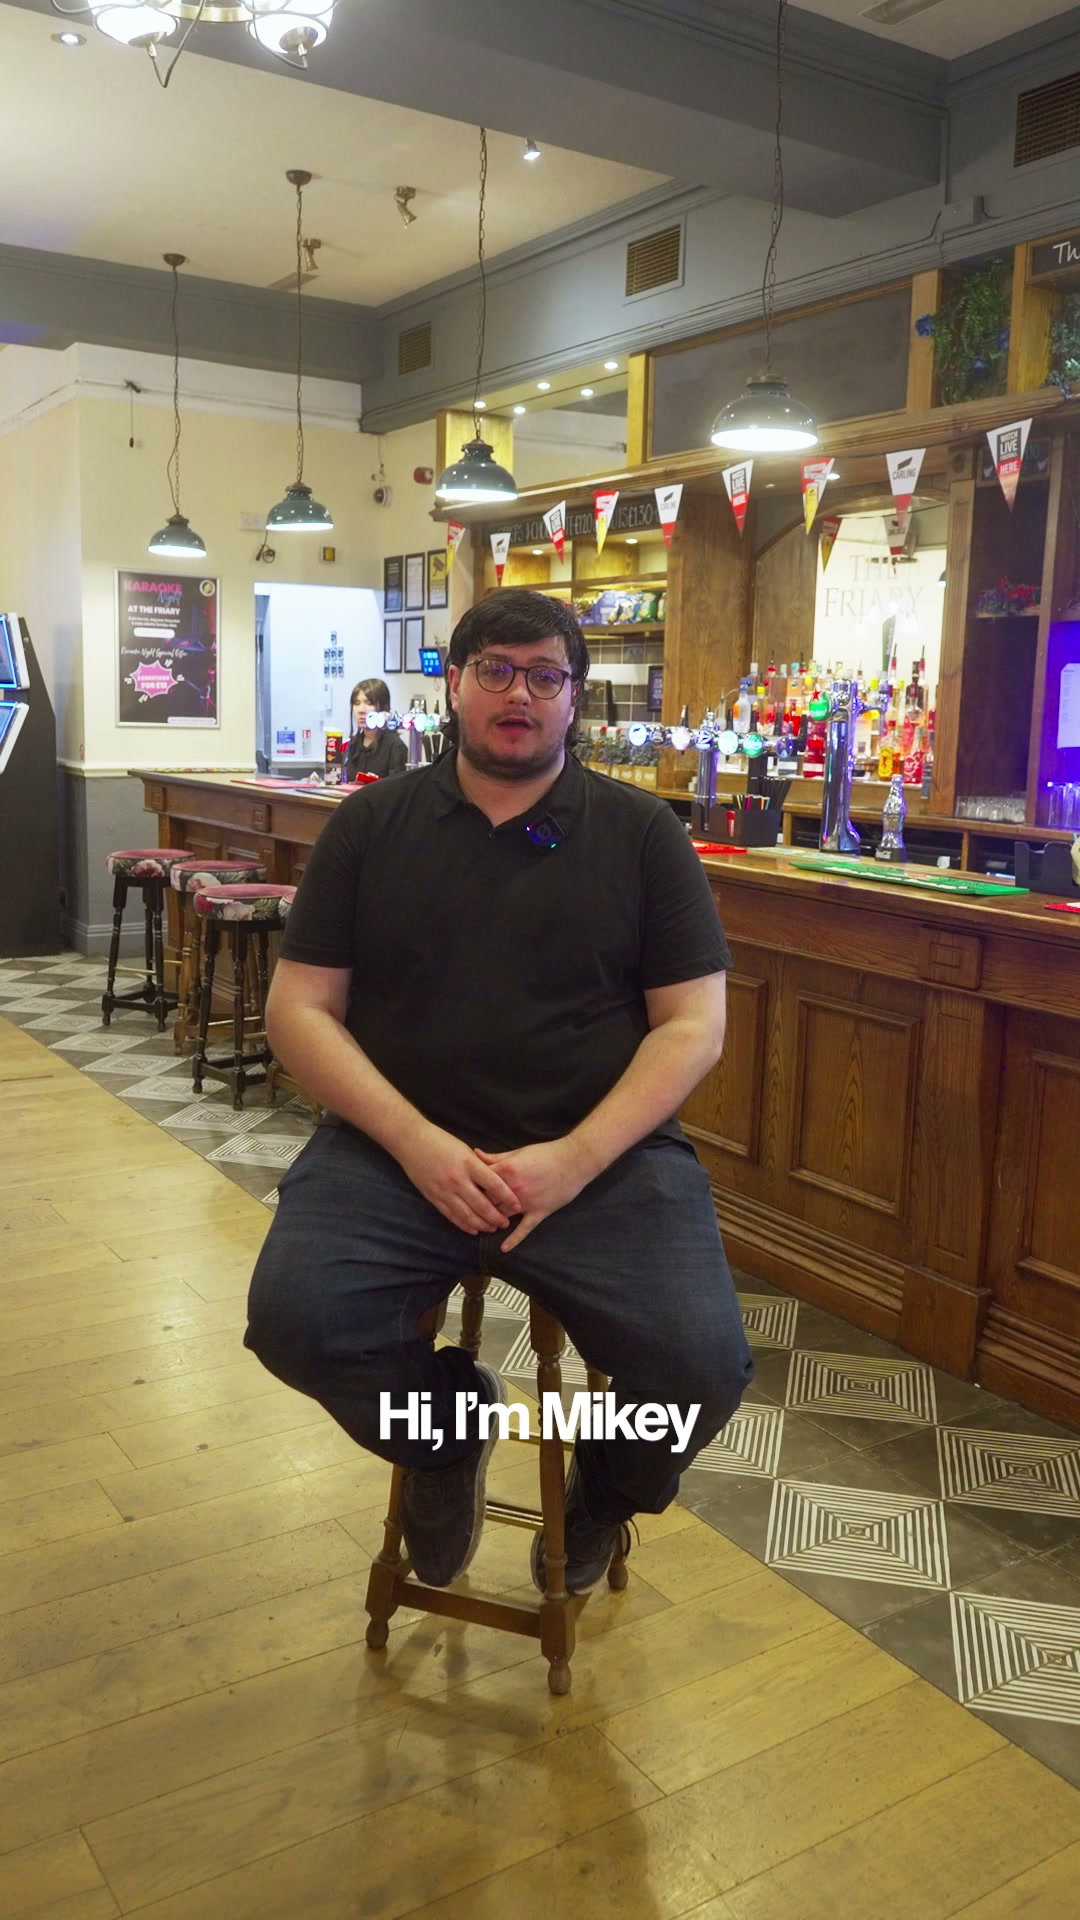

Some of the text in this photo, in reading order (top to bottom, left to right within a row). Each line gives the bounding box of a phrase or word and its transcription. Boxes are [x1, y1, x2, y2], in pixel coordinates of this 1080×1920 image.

[1000, 430, 1019, 443] WATCH
[1000, 438, 1018, 455] LIVE
[892, 467, 917, 480] CARLING
[1000, 460, 1018, 475] HERE
[124, 580, 182, 593] KARAOKE
[157, 590, 183, 608] Night
[824, 584, 924, 619] FRIARY
[128, 604, 180, 615] AT THE FRIARY
